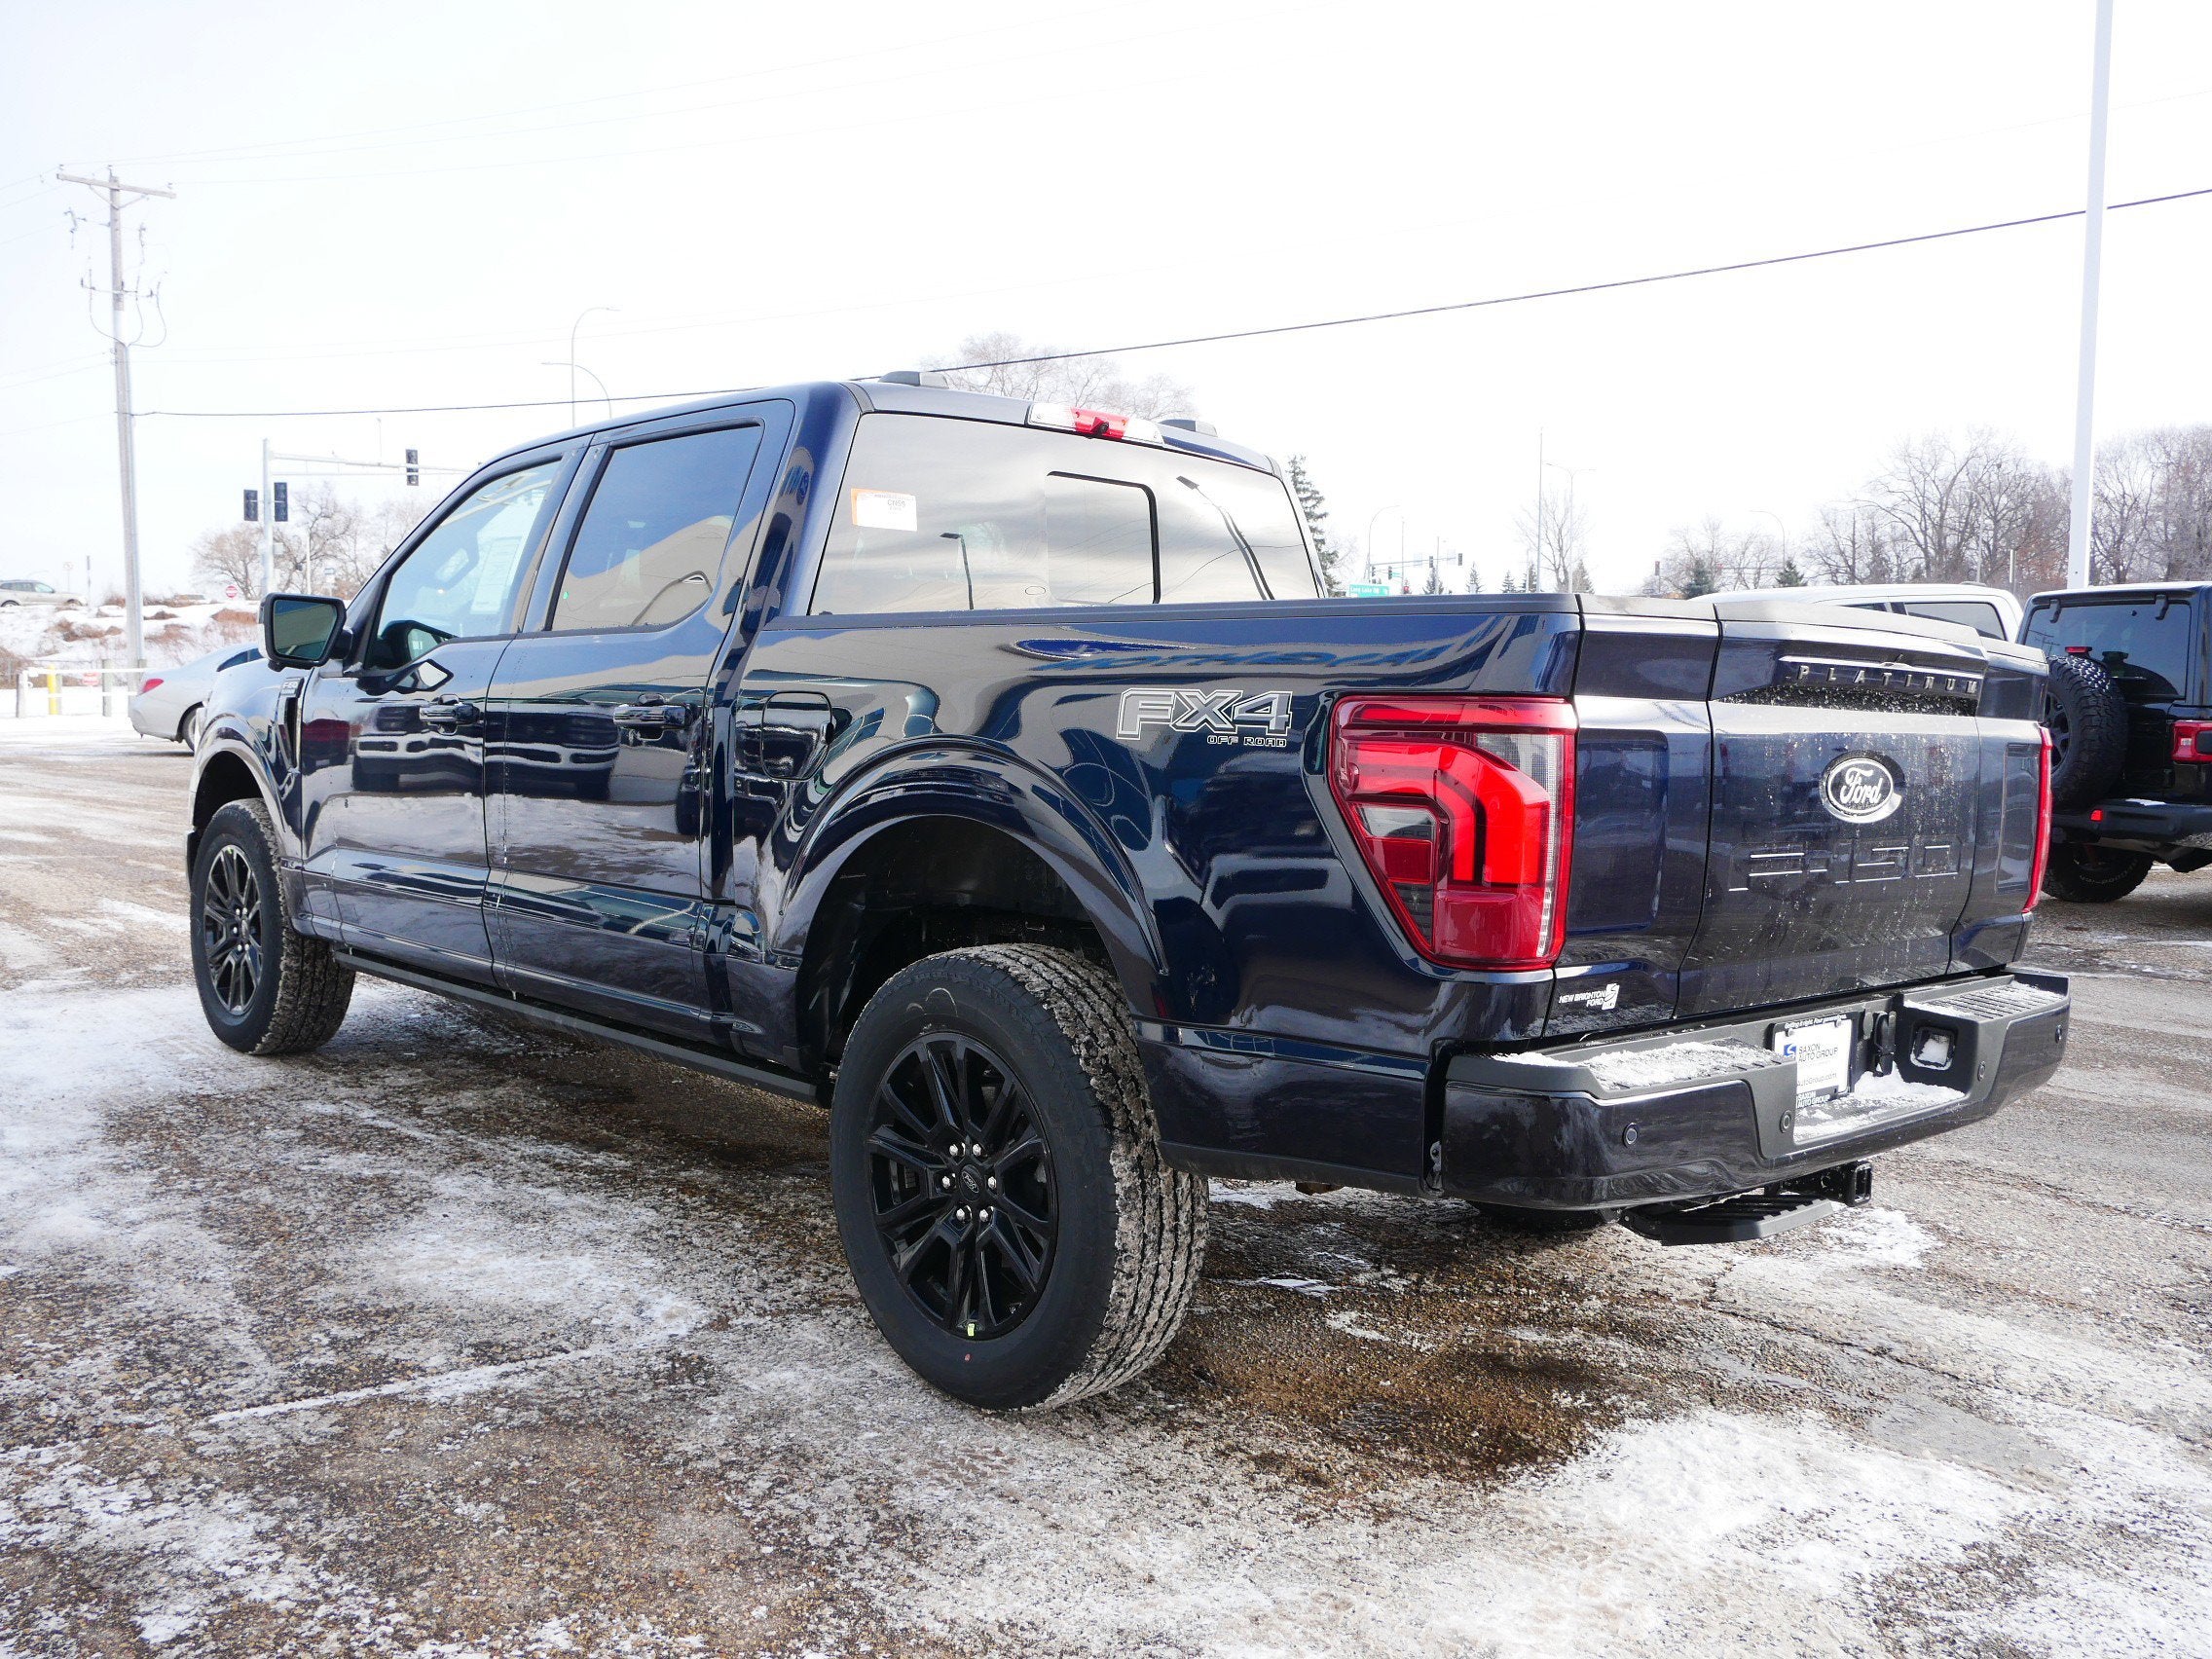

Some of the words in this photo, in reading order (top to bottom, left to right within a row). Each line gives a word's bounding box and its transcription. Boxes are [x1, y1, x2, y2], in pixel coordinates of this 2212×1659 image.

[1797, 665, 1977, 695] PLATINUM
[1117, 688, 1294, 740] FX4
[1207, 734, 1238, 746] OFF
[1243, 735, 1287, 748] ROAD
[1839, 766, 1881, 804] Ford
[1728, 838, 1963, 893] F-150
[1559, 994, 1574, 1004] NEW
[1574, 990, 1606, 1002] BRIGHTON
[1586, 998, 1604, 1007] FORD
[1798, 1051, 1816, 1063] AUTO
[1816, 1047, 1839, 1059] GROUP
[1799, 1043, 1821, 1054] SAXON
